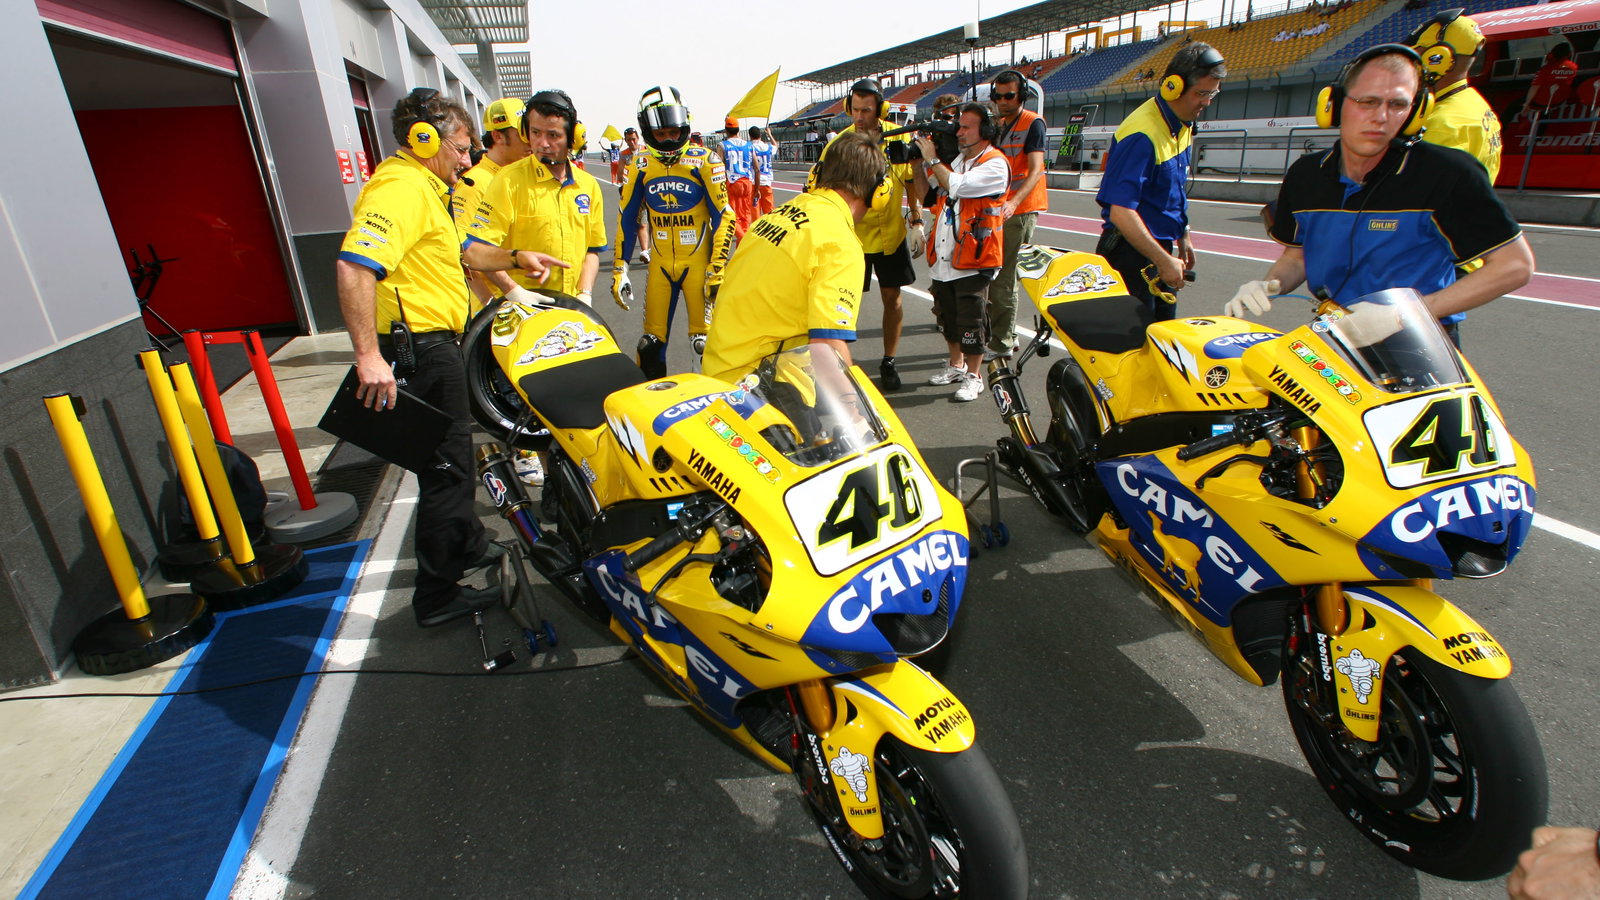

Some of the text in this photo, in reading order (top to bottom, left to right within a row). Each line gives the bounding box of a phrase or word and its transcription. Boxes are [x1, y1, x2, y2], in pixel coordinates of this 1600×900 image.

[1561, 23, 1598, 33] Castrol
[648, 182, 692, 195] CAMEL
[365, 220, 388, 234] MOTUL
[366, 212, 394, 229] CAMEL
[652, 215, 695, 228] YAMAHA
[719, 219, 736, 260] YAMAHA
[1268, 364, 1322, 416] YAMAHA
[1291, 342, 1361, 403] THE DOCTOR
[707, 415, 781, 483] THE DOCTOR
[687, 448, 741, 505] YAMAHA
[815, 452, 925, 554] 46
[1391, 478, 1534, 543] CAMEL
[1117, 463, 1264, 594] CAMEL
[828, 533, 967, 634] CAMEL
[1317, 632, 1332, 682] brembo
[1443, 632, 1493, 650] MOTUL
[1450, 645, 1506, 665] YAMAHA
[914, 697, 955, 731] MOTUL
[924, 710, 970, 744] YAMAHA
[808, 734, 829, 785] brembo
